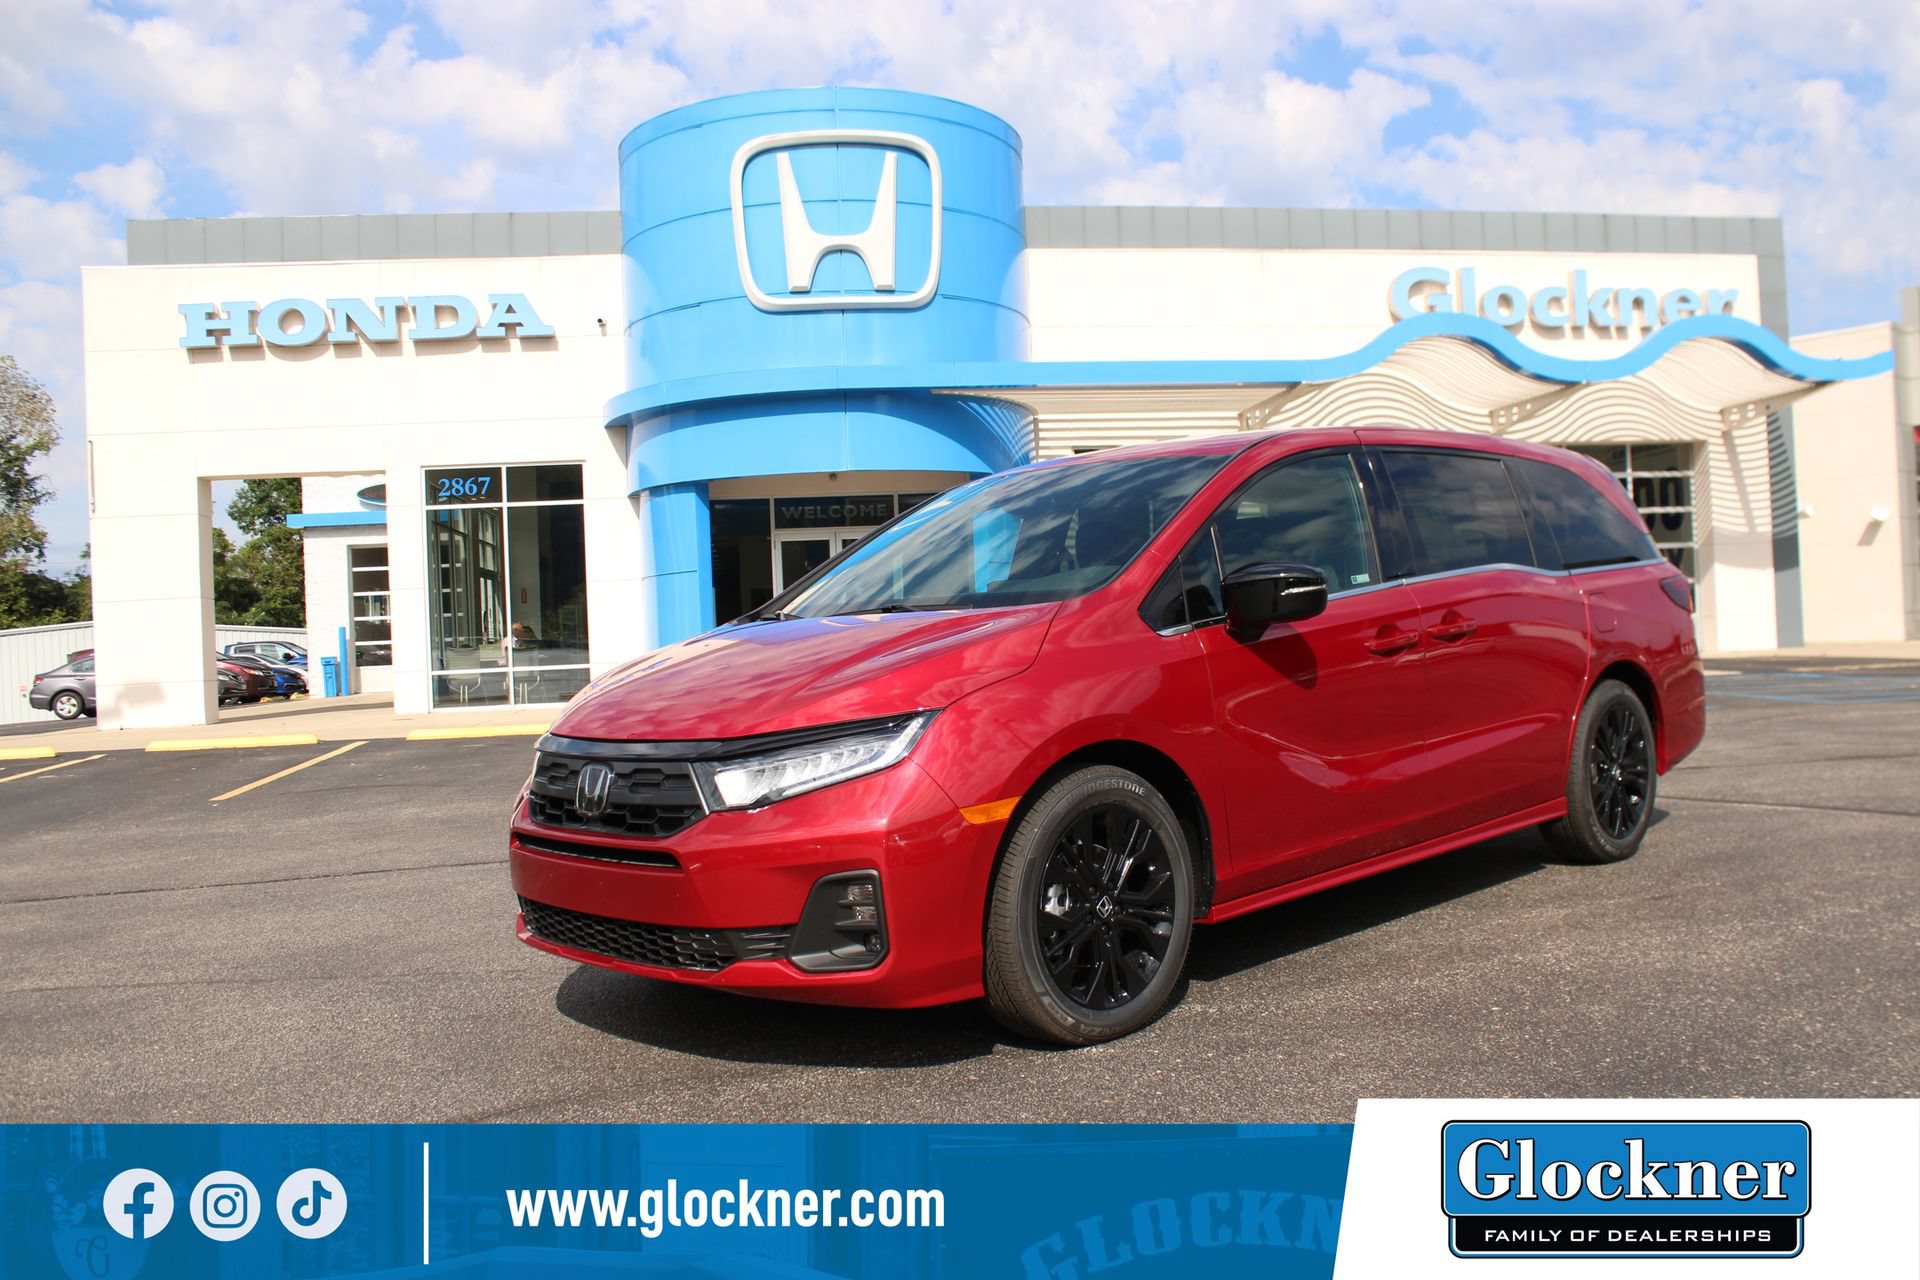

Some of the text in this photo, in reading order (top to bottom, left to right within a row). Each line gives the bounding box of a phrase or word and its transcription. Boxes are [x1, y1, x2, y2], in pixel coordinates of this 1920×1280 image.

[1388, 266, 1739, 332] Glockner
[178, 293, 555, 348] HONDA
[438, 476, 491, 497] 2867
[782, 504, 887, 519] WELCOME
